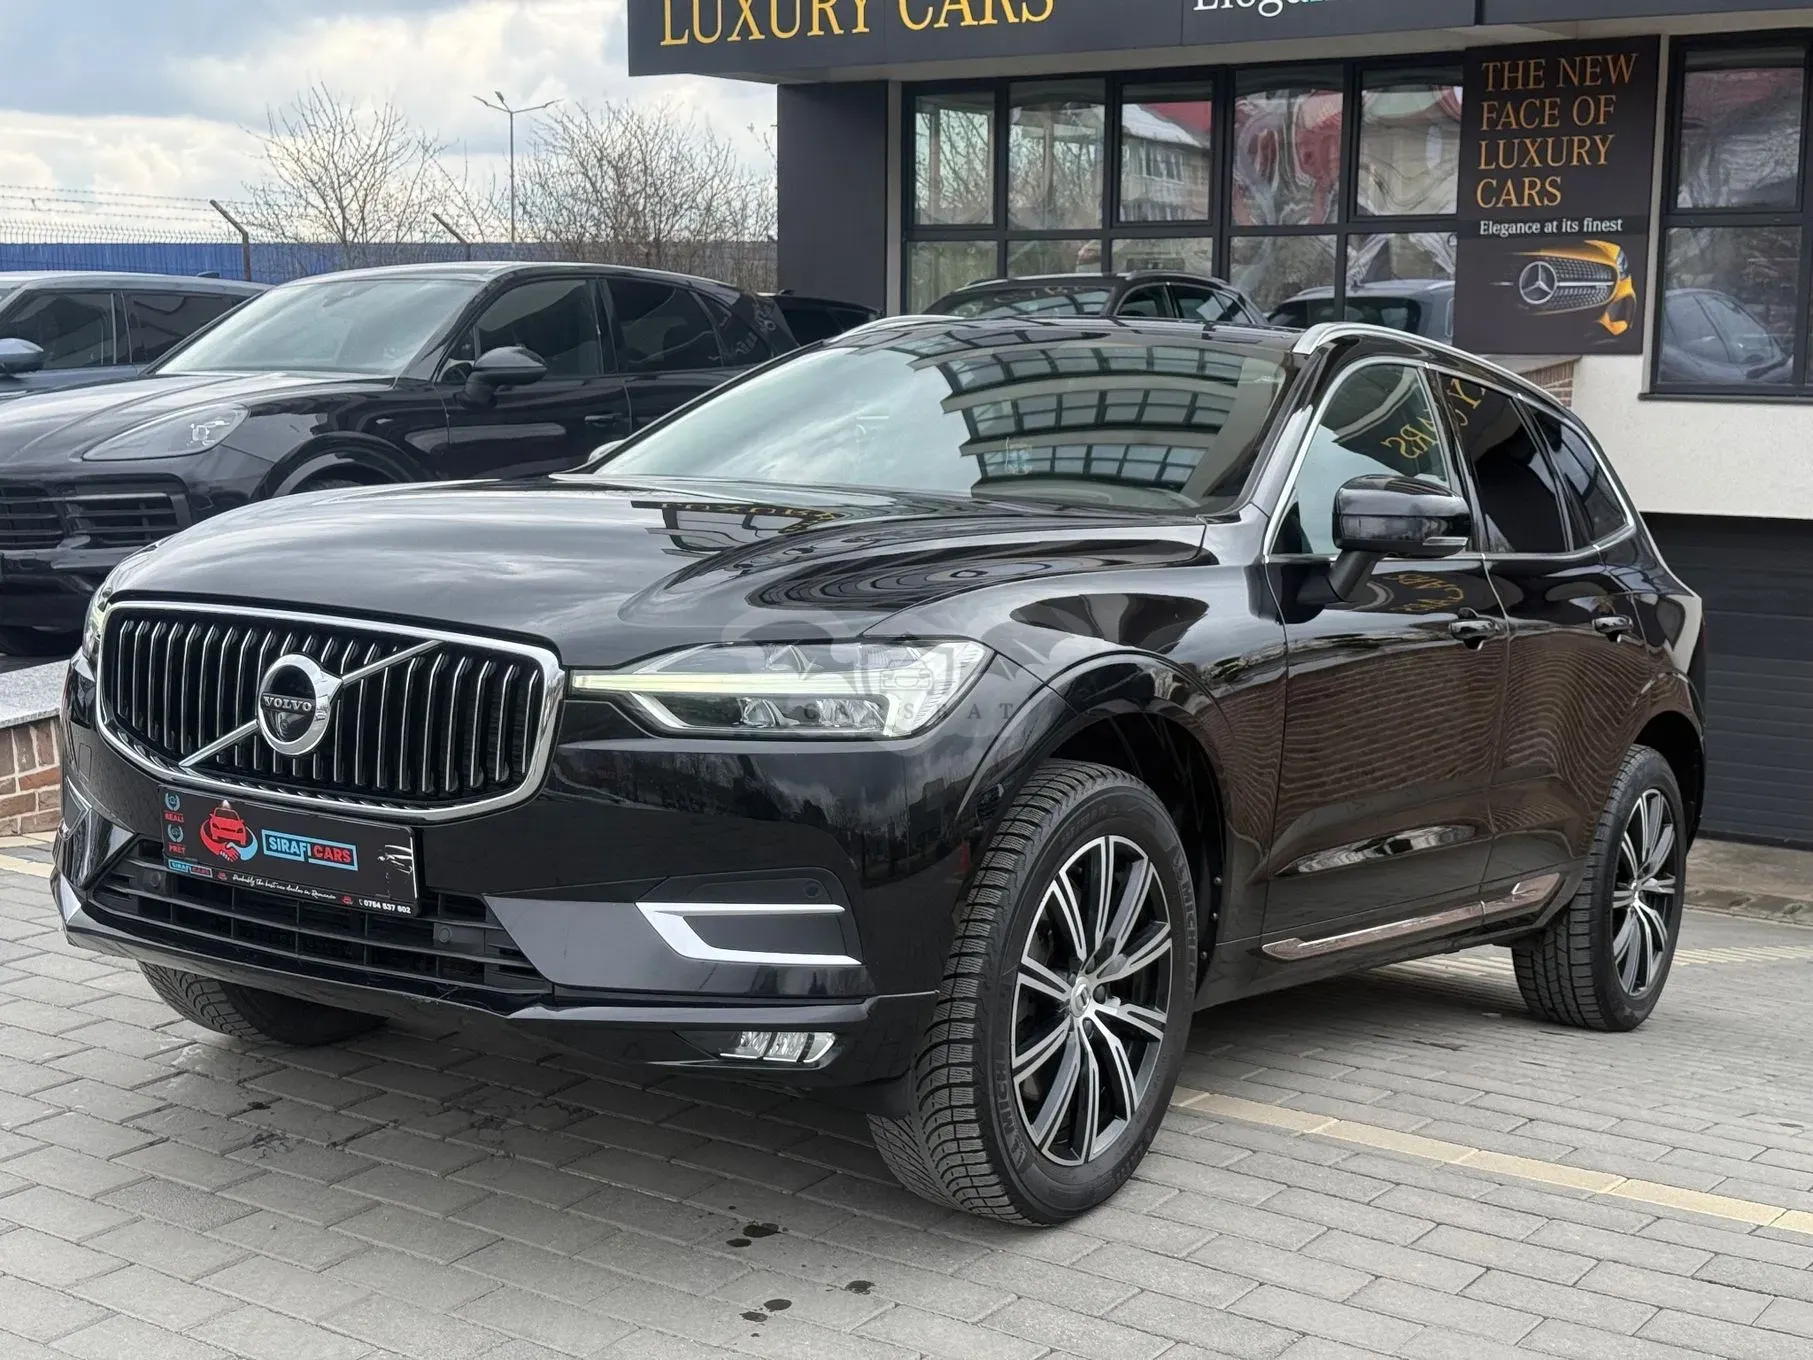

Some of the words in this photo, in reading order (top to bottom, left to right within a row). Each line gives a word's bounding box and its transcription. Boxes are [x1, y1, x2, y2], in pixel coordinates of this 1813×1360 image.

[1481, 59, 1546, 92] THE
[1556, 53, 1639, 88] NEW
[1480, 97, 1561, 131] FACE
[1572, 95, 1616, 126] OF
[1478, 134, 1616, 170] LUXURY
[1476, 176, 1562, 208] CARS
[1480, 220, 1541, 237] Elegance
[1544, 220, 1557, 233] at
[1562, 218, 1579, 233] its
[1583, 217, 1623, 232] finest
[263, 696, 312, 712] VOLVO
[268, 837, 312, 857] SIRAFI
[313, 845, 351, 863] CARS
